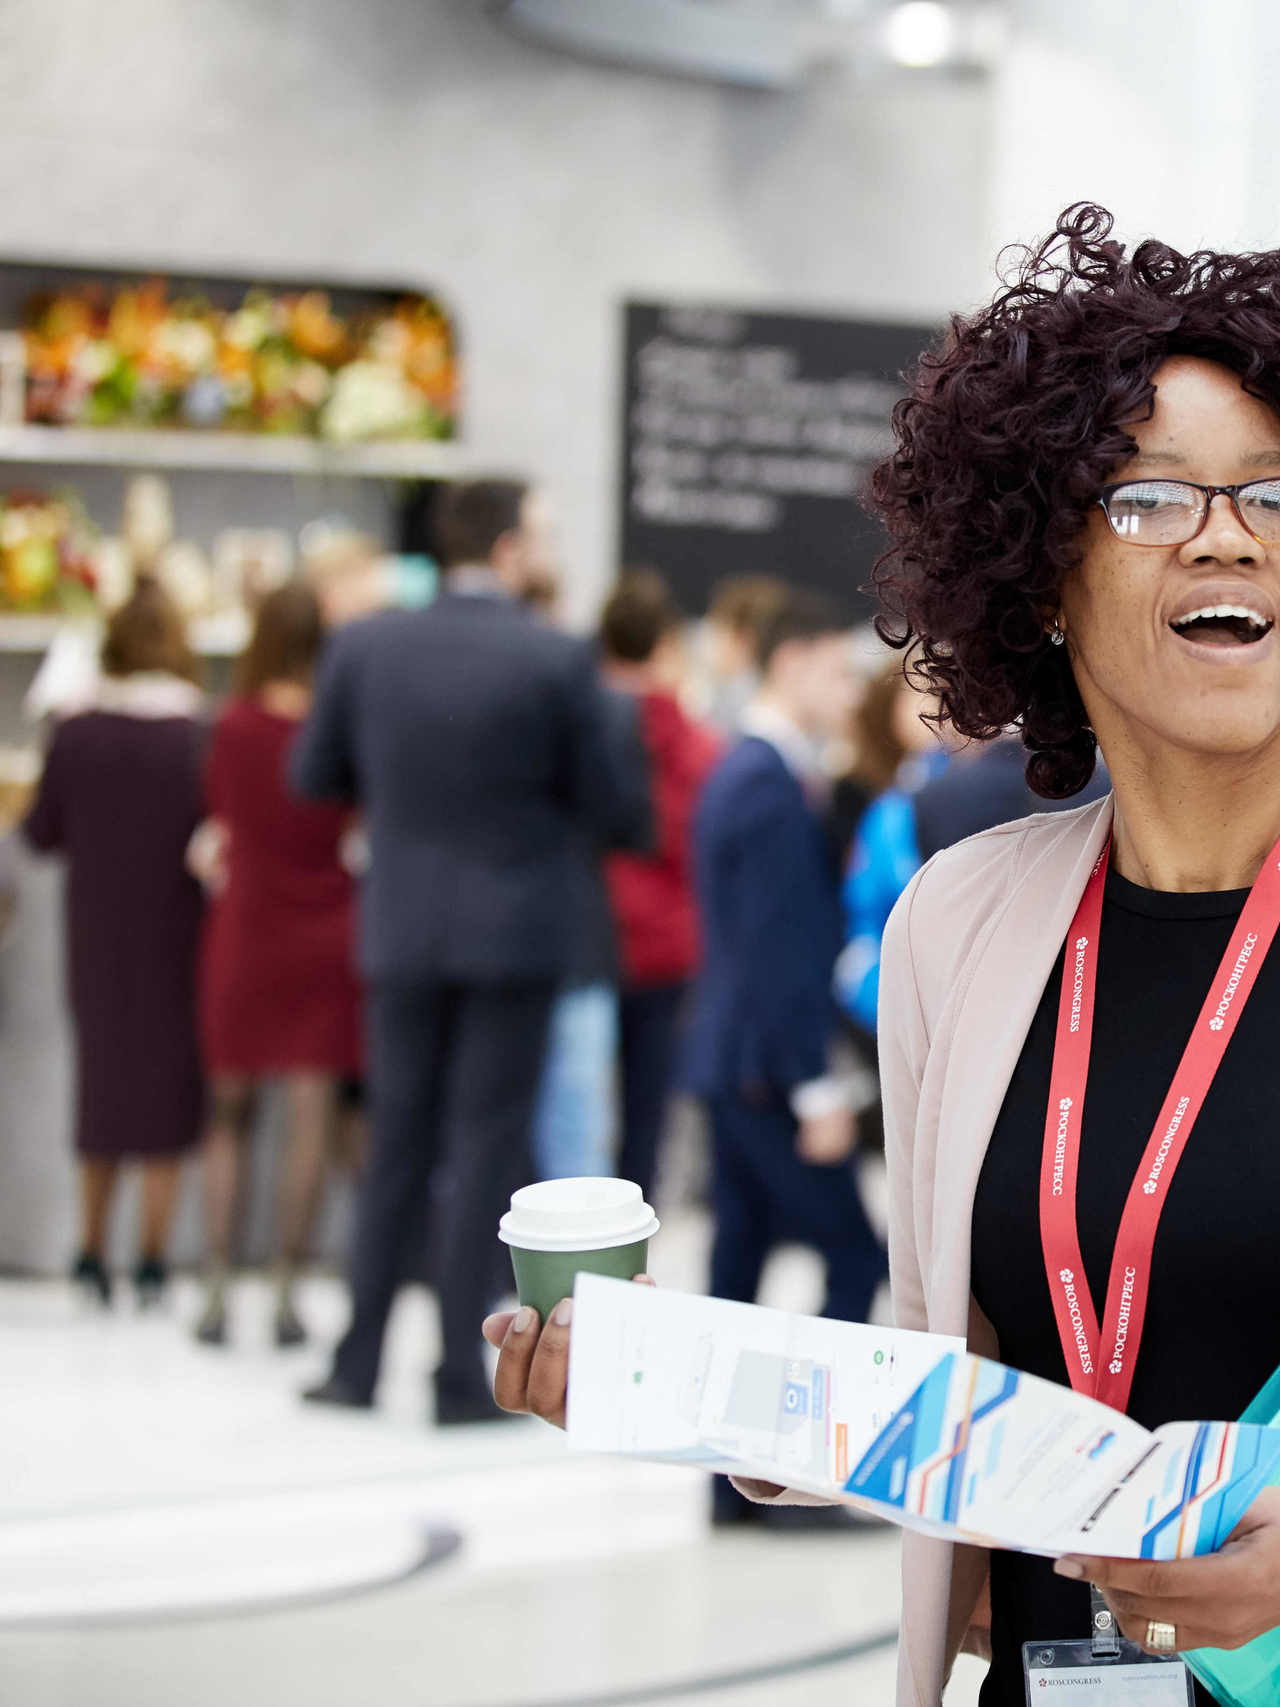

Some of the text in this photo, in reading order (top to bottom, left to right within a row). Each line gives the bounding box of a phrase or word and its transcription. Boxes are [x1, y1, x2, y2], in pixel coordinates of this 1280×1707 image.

[1069, 950, 1085, 1033] ROSCONGRESS
[1216, 932, 1258, 1017] РОСКОНГРЕСС
[1052, 1111, 1070, 1196] РОСКОНГРЕСС
[1150, 1096, 1191, 1180] ROSCONGRESS
[1064, 1284, 1094, 1374] ROSCONGRESS
[1113, 1266, 1137, 1359] РОСКОНГРЕСС
